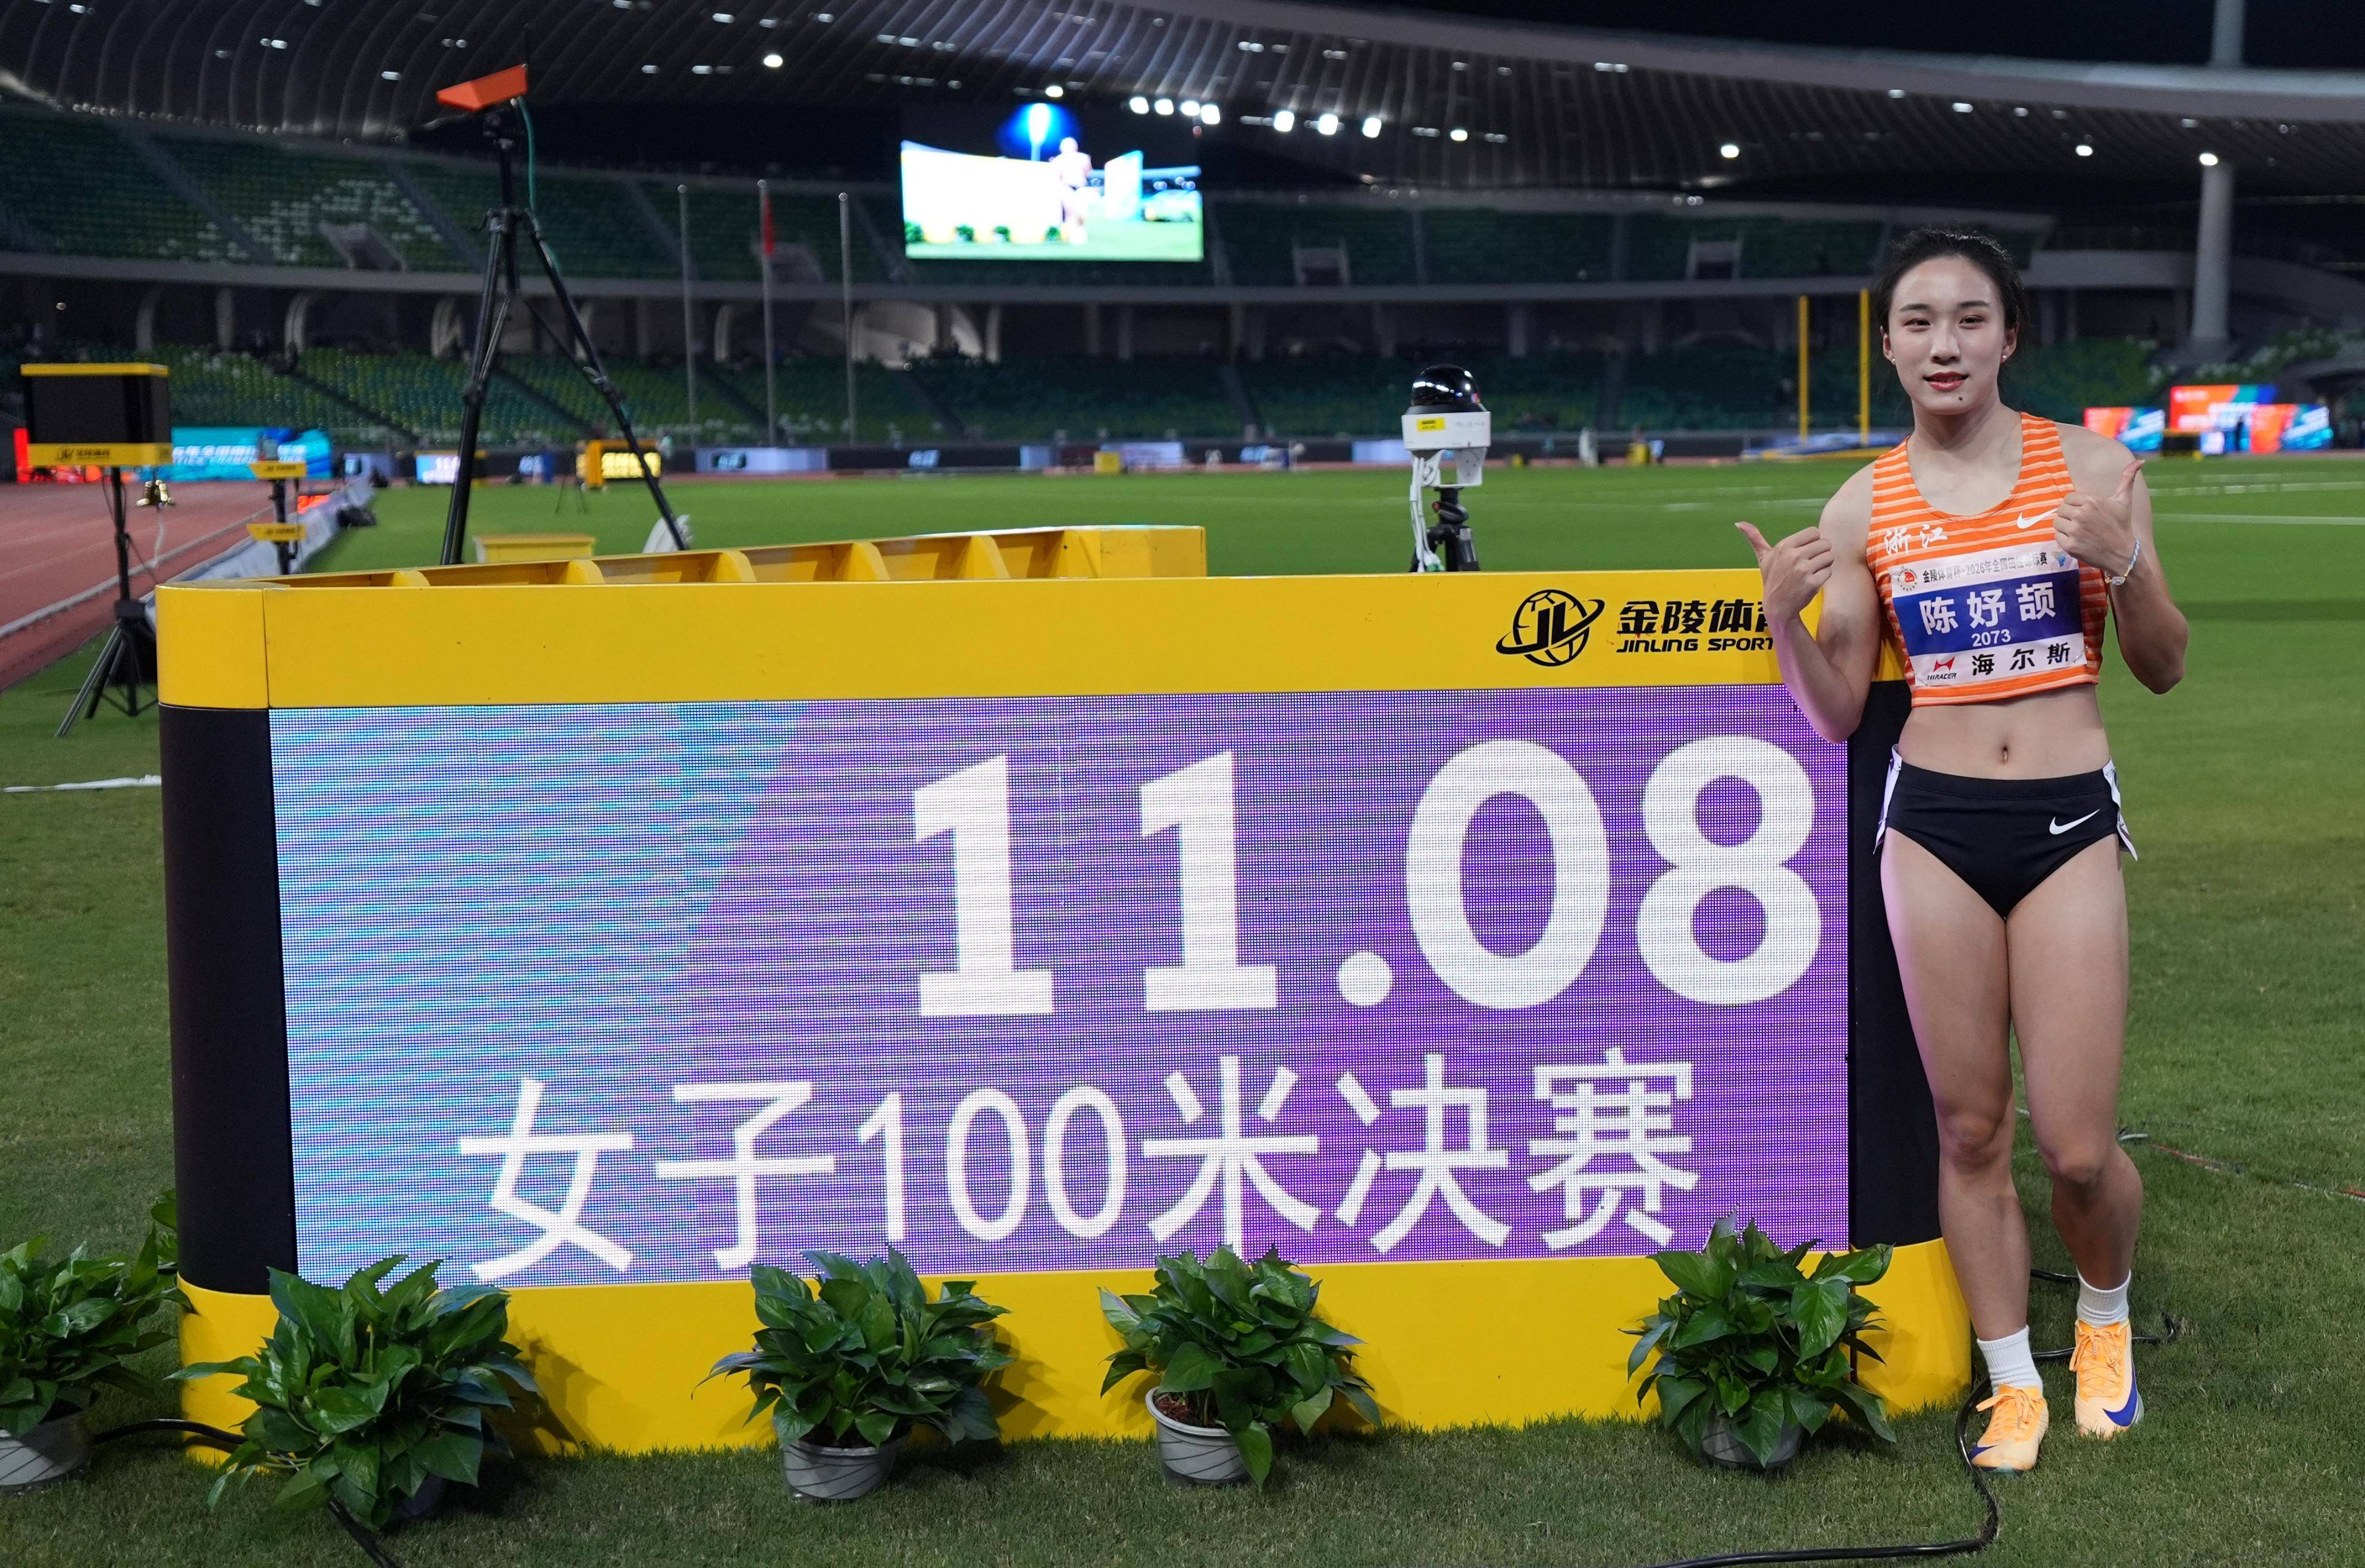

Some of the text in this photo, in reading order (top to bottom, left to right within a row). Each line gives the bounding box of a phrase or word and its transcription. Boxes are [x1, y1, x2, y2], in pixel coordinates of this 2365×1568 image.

[1884, 524, 1947, 555] 浙江
[1919, 581, 2056, 635] 陈妤颉
[1616, 637, 1698, 653] JINLING
[1971, 629, 2011, 647] 2073
[1972, 642, 2070, 676] 海尔斯
[913, 735, 1823, 1017] 11.08
[460, 1046, 1702, 1282] 女子100米决赛
